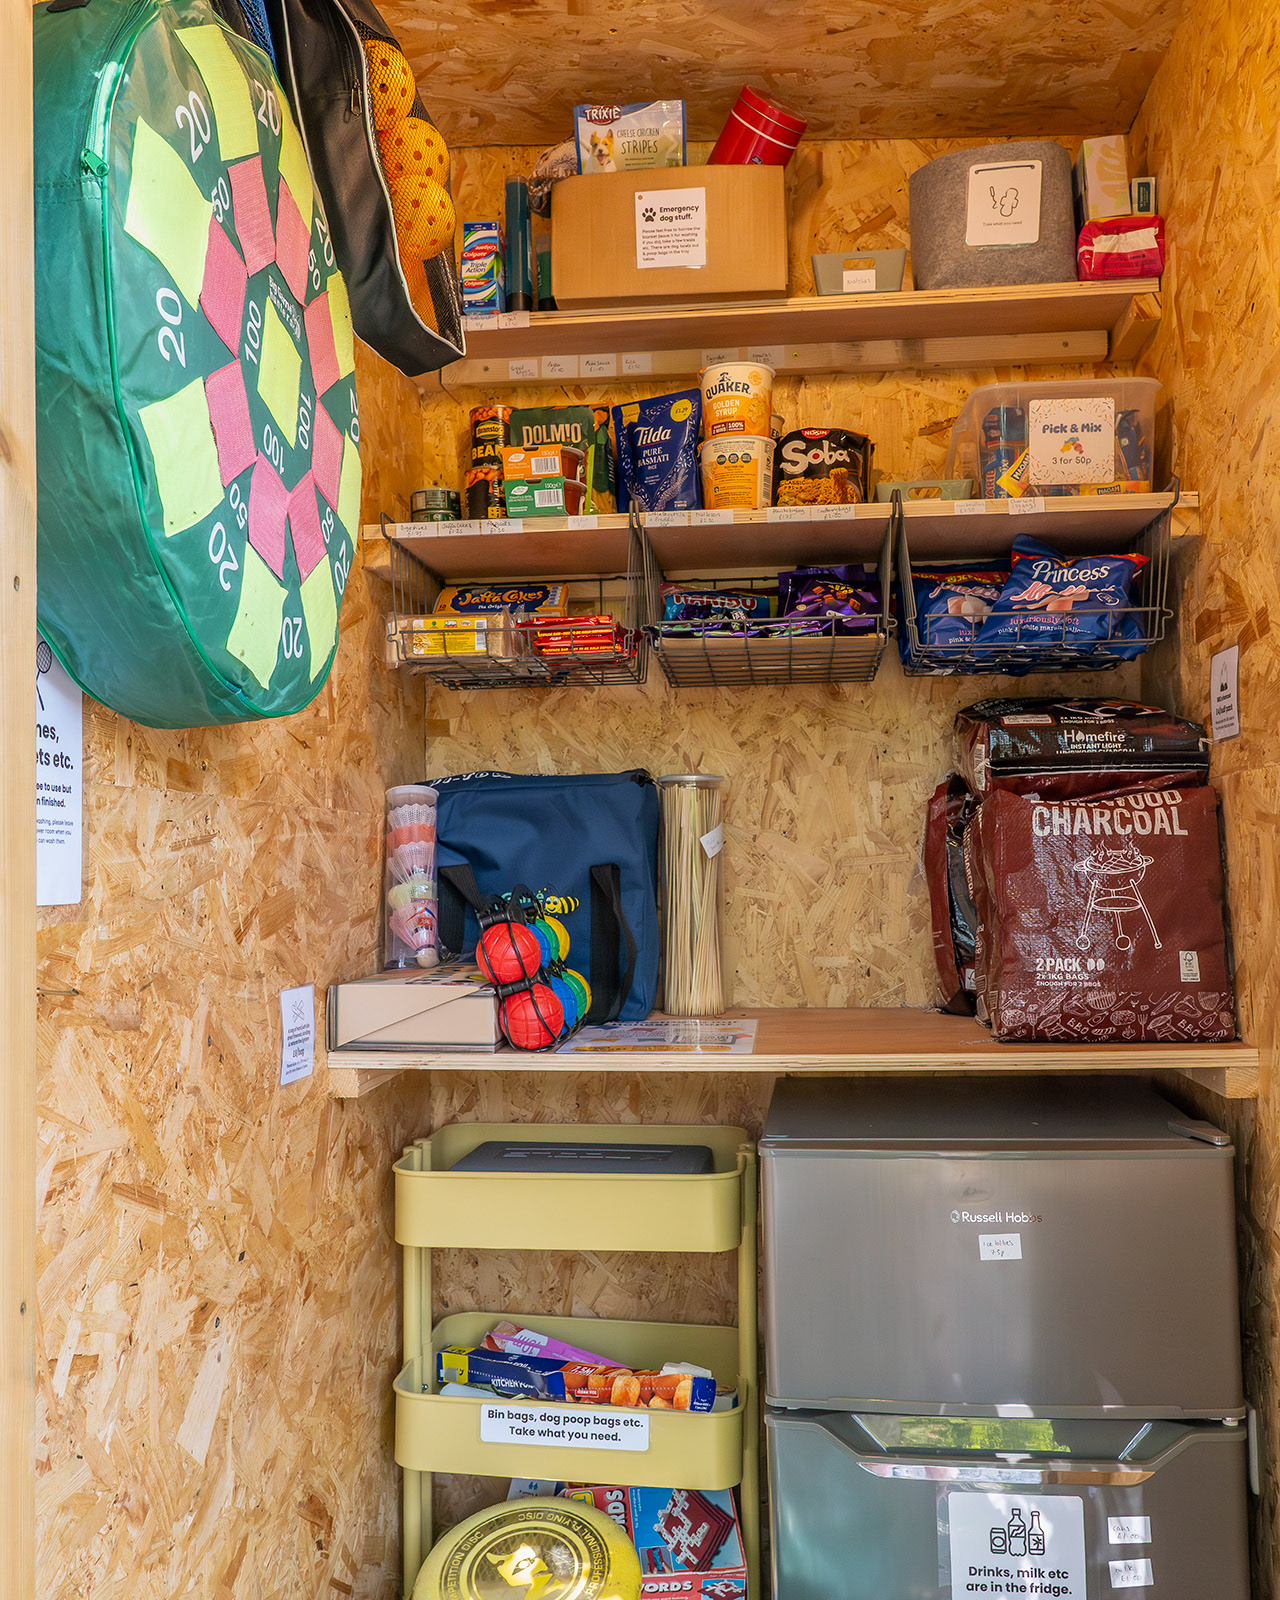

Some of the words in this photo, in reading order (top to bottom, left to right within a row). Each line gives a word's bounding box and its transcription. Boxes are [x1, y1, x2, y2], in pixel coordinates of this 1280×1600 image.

[253, 79, 281, 136] 20
[585, 105, 621, 120] TRIXIE
[175, 90, 211, 163] 20
[616, 129, 634, 138] CHEESE
[637, 128, 660, 137] CHICKEN
[621, 140, 658, 154] STRIPES
[211, 177, 230, 223] 50
[660, 214, 673, 222] dog
[314, 216, 335, 267] 20
[307, 249, 321, 290] 50
[155, 287, 187, 368] 20
[244, 300, 262, 366] 100
[706, 382, 750, 399] QUAKER
[713, 400, 740, 409] GOLDEN
[716, 408, 737, 417] SYRUP
[298, 392, 312, 450] 100
[349, 388, 362, 442] 20
[634, 426, 672, 446] Tilda
[1042, 424, 1068, 434] Pick
[1070, 424, 1079, 433] &
[1081, 423, 1102, 433] Mix
[263, 424, 285, 475] 100
[643, 447, 662, 457] PURE
[780, 440, 850, 474] Soba
[638, 454, 669, 467] BASMATI
[1075, 456, 1092, 465] 50p
[229, 483, 248, 530] 50
[322, 506, 335, 544] 50
[208, 521, 240, 591] 20
[334, 539, 350, 596] 20
[1032, 561, 1110, 583] Princess
[459, 591, 502, 606] Jaffa
[502, 590, 543, 604] Cakes
[281, 616, 304, 660] 20
[53, 752, 74, 770] etc.
[44, 783, 50, 791] to
[51, 784, 61, 792] use
[62, 784, 72, 794] but
[42, 797, 66, 807] finished.
[1032, 805, 1188, 837] CHARCOAL
[962, 1211, 1002, 1223] Russell
[1005, 1212, 1042, 1223] Hobbs
[492, 1379, 518, 1388] KITCHEN
[487, 1410, 505, 1420] Bin
[507, 1410, 537, 1423] bags,
[539, 1412, 560, 1426] dog
[563, 1415, 590, 1427] poop
[593, 1415, 621, 1428] bags
[623, 1417, 644, 1428] etc.
[509, 1426, 535, 1437] Take
[537, 1427, 565, 1438] what
[567, 1430, 588, 1441] you
[591, 1431, 621, 1442] need.
[518, 1512, 544, 1521] DISC
[546, 1513, 582, 1532] FLYING
[463, 1531, 484, 1551] DISC
[582, 1528, 603, 1597] PROFESSIONAL
[969, 1566, 1013, 1579] Drinks,
[1017, 1567, 1045, 1578] milk
[1048, 1569, 1069, 1579] etc
[966, 1583, 988, 1592] are
[990, 1581, 1002, 1592] in
[1005, 1582, 1026, 1593] the
[1029, 1582, 1072, 1597] fridge.
